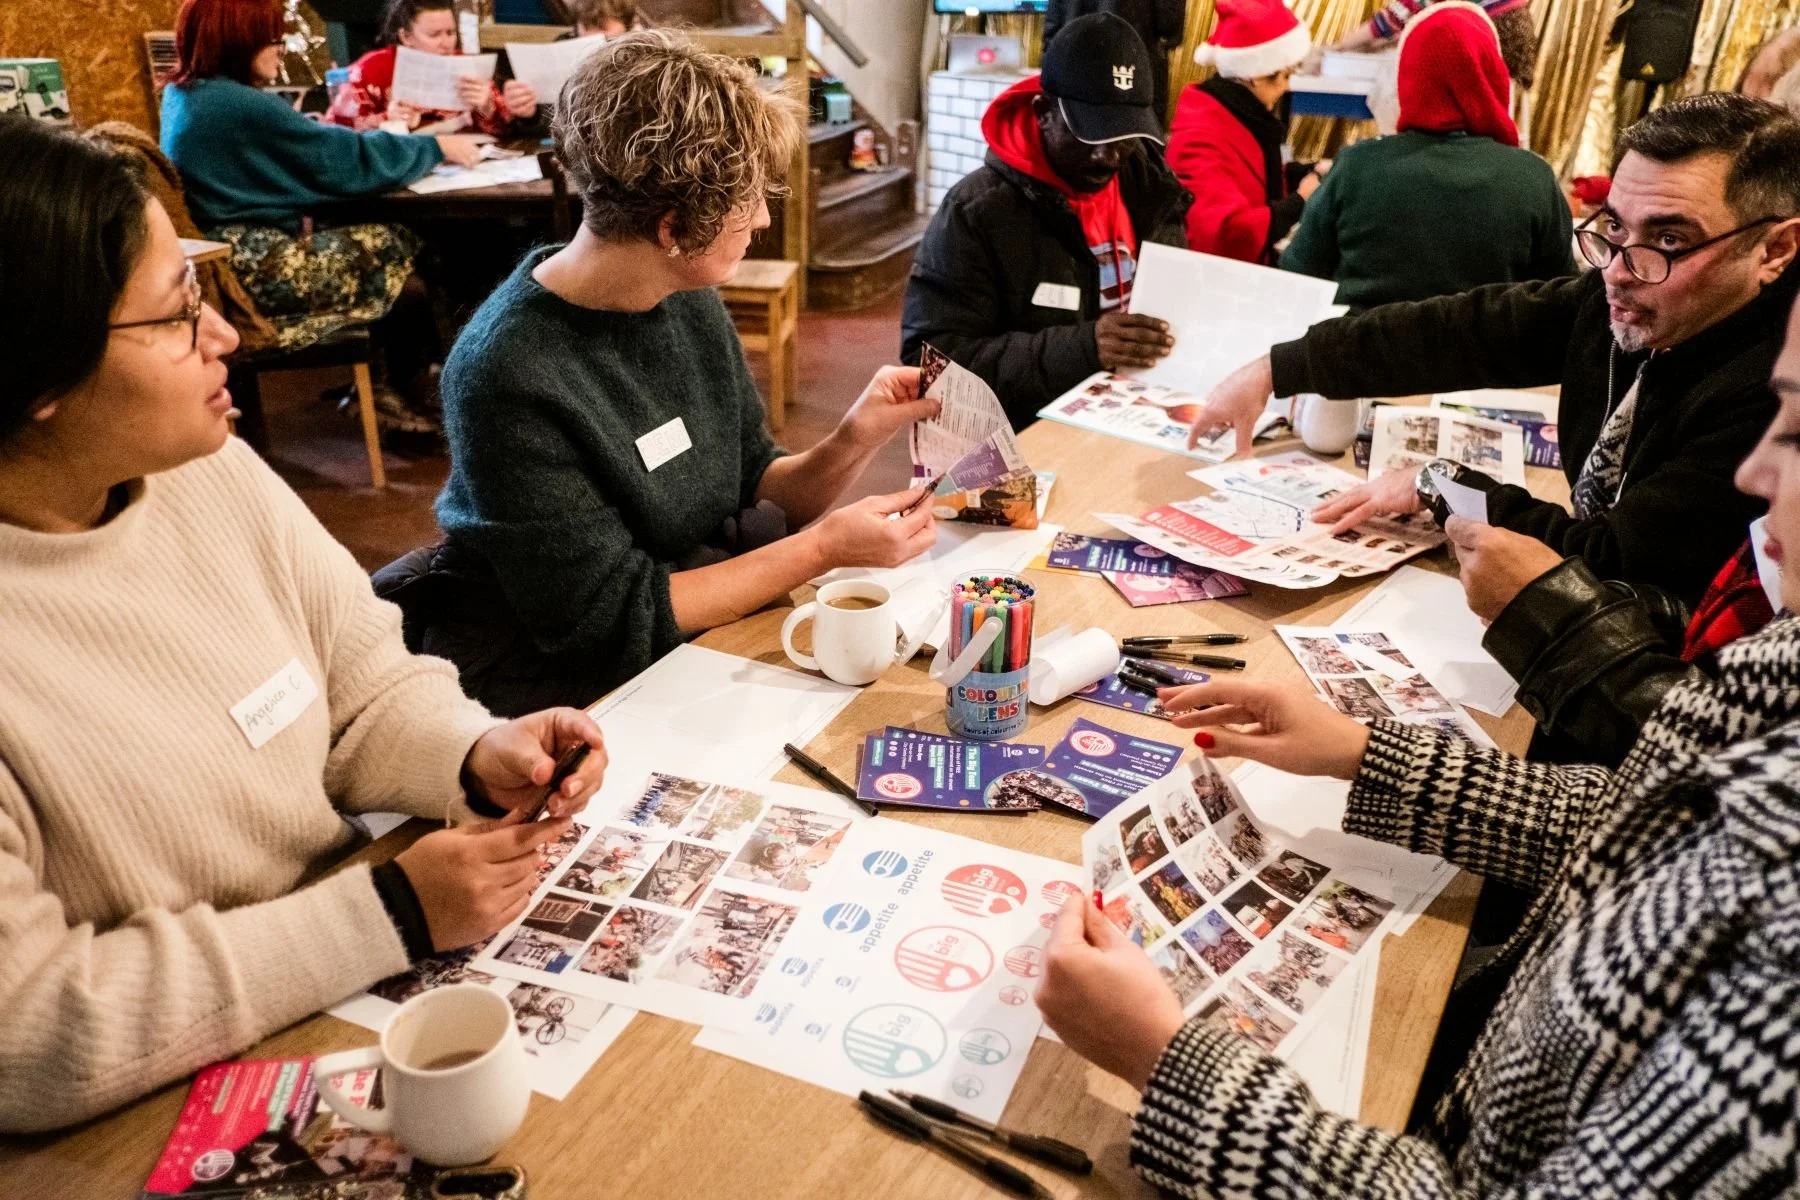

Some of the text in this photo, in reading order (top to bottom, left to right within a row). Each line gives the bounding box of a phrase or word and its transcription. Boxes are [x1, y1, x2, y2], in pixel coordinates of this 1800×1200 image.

[977, 702, 1019, 722] PENS
[897, 848, 934, 896] appetite
[971, 867, 995, 888] big
[859, 901, 900, 953] appetite
[934, 934, 960, 956] big
[883, 1012, 912, 1037] big
